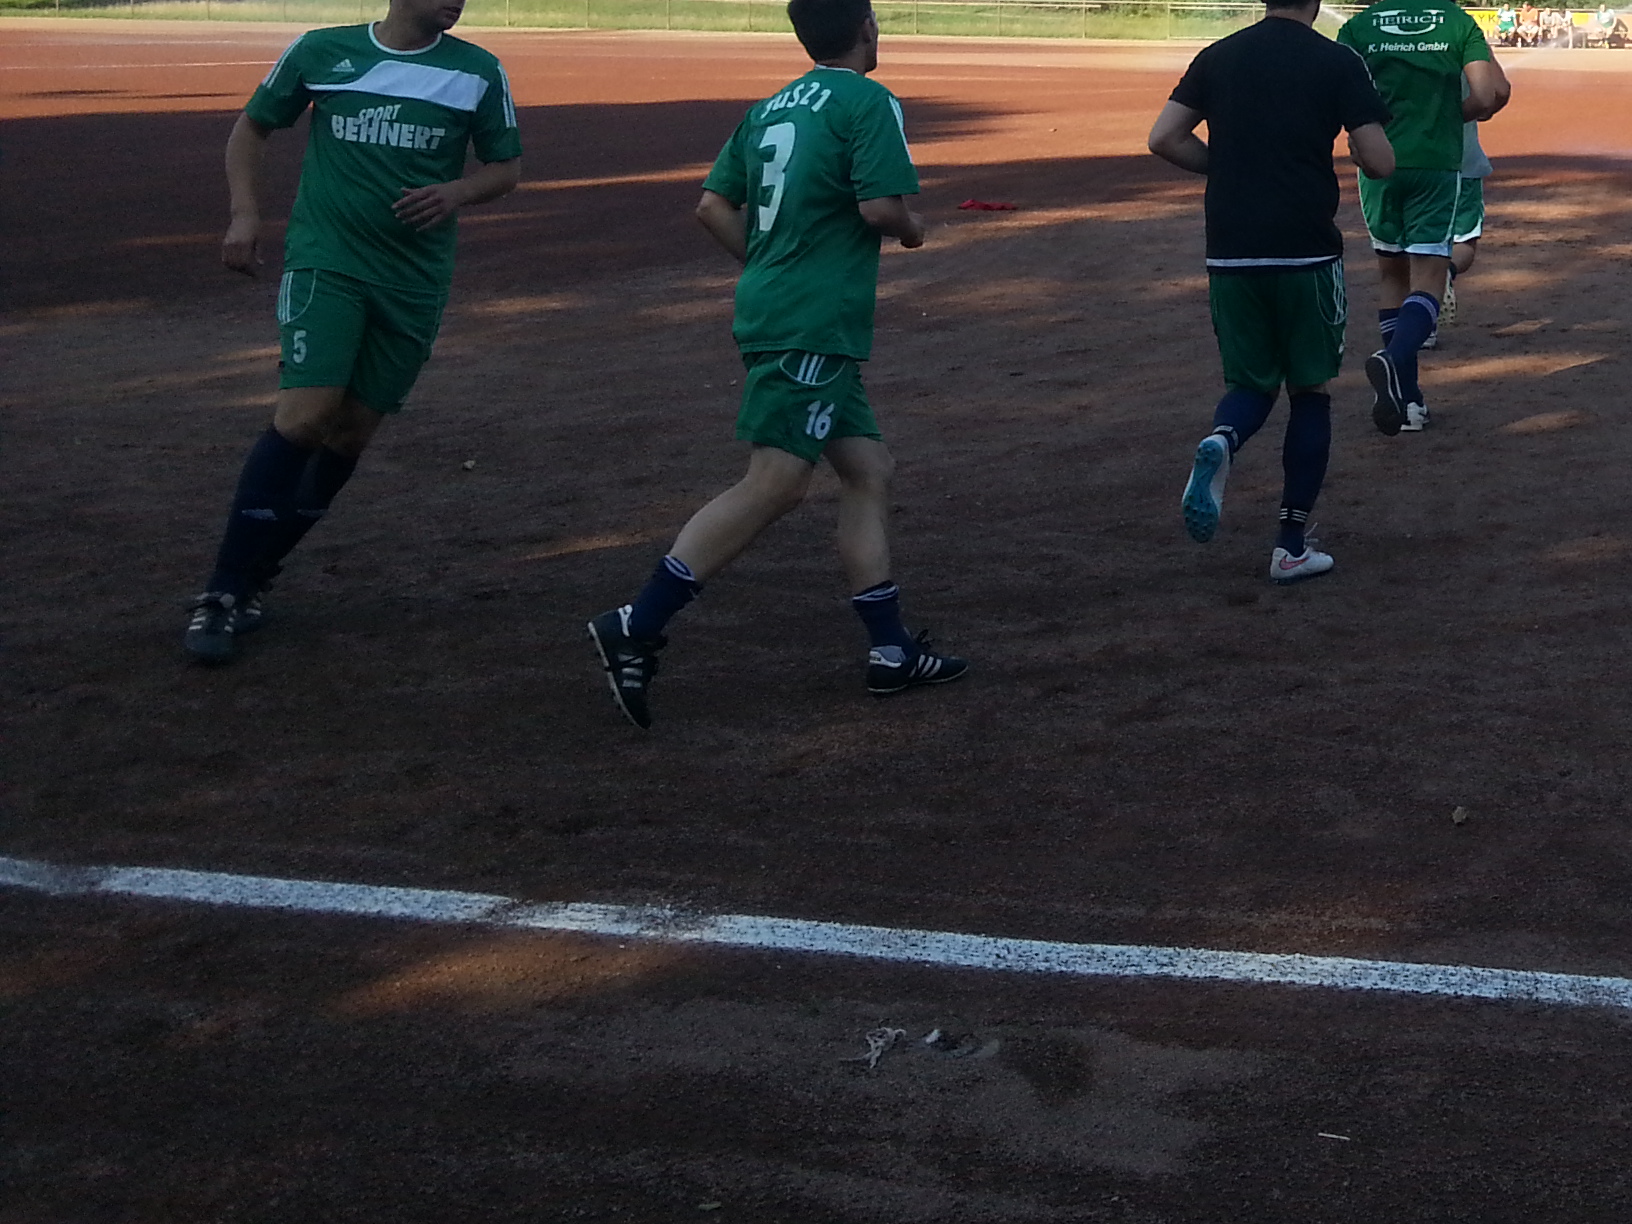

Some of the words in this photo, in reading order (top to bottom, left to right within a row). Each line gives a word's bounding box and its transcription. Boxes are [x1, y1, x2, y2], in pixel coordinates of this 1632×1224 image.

[1372, 15, 1444, 26] HEIRICH
[1380, 42, 1415, 52] Heirich
[1417, 42, 1449, 52] GmbH
[358, 104, 401, 123] SPORT
[331, 114, 445, 150] BEHNERT
[758, 122, 796, 231] 3
[293, 329, 307, 363] 5
[806, 400, 835, 440] 16
